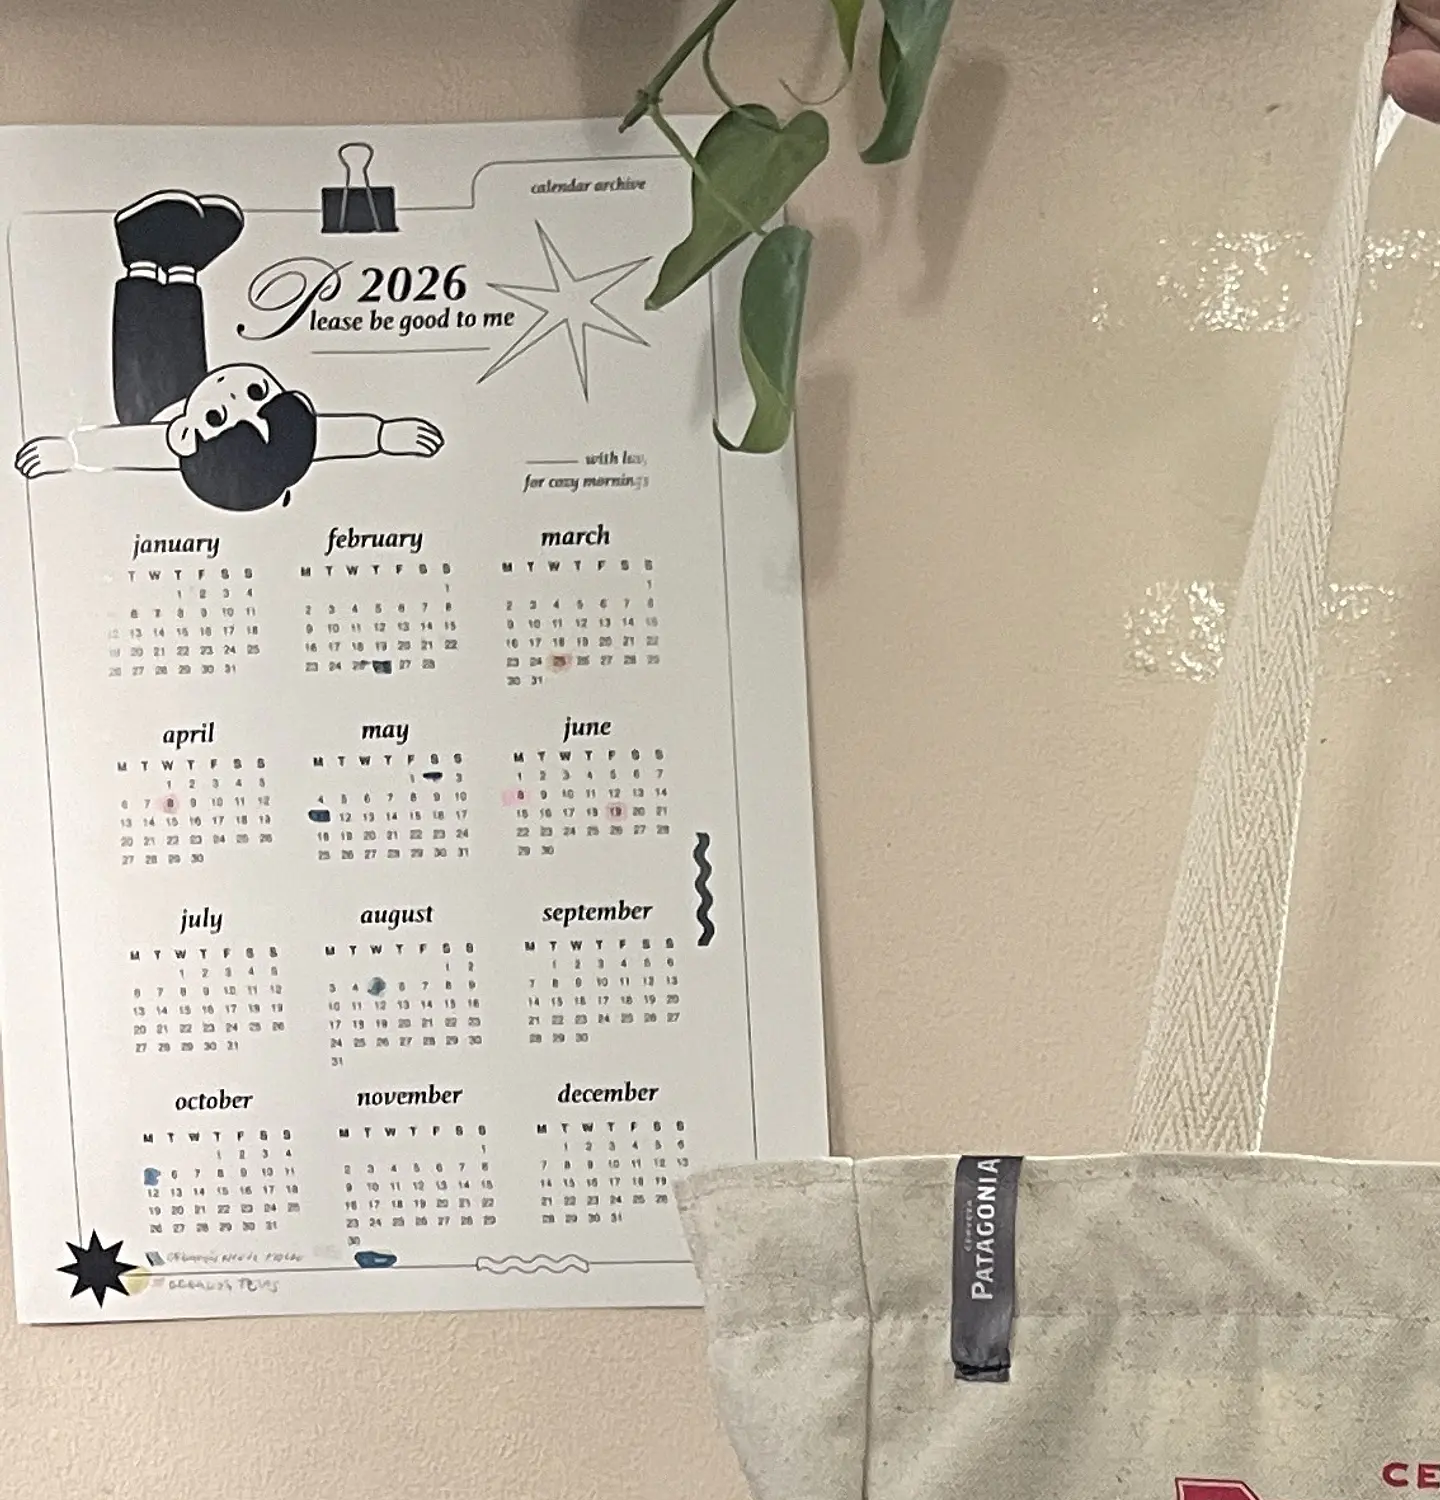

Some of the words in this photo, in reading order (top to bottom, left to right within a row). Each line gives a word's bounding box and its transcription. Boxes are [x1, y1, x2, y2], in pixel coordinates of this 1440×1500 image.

[530, 178, 592, 194] calendar
[594, 176, 647, 192] archive
[357, 264, 467, 303] 2026
[369, 310, 395, 330] be
[399, 307, 450, 337] good
[456, 308, 477, 328] to
[483, 311, 516, 328] me
[585, 450, 619, 465] with
[523, 473, 546, 493] for
[548, 478, 580, 493] cozy
[133, 534, 219, 560] january
[324, 527, 422, 556] february
[542, 524, 609, 546] march
[163, 722, 214, 750] april
[362, 724, 408, 745] may
[563, 717, 611, 741] june
[180, 907, 222, 934] july
[361, 906, 433, 930] august
[543, 900, 653, 926] september
[175, 1089, 253, 1110] october
[357, 1084, 463, 1106] november
[558, 1081, 659, 1103] december
[971, 1157, 1002, 1300] PATAGONIA
